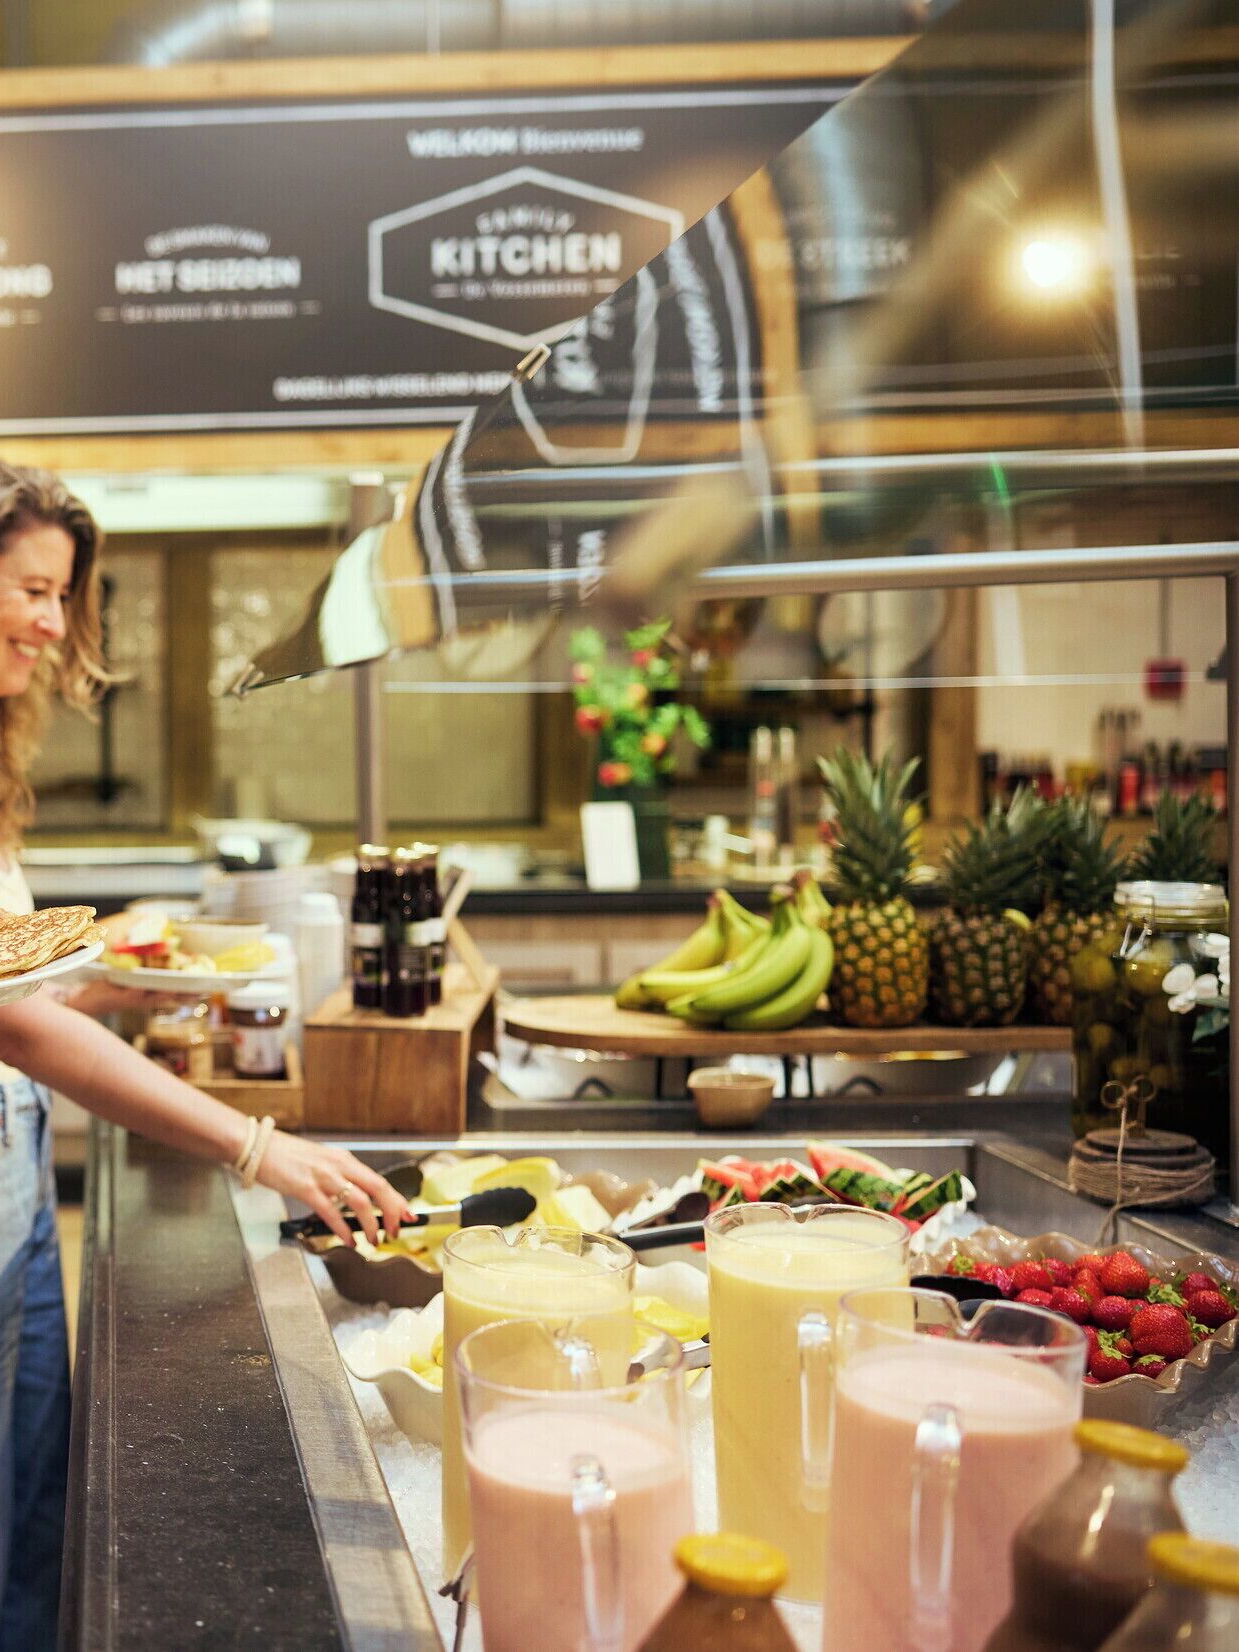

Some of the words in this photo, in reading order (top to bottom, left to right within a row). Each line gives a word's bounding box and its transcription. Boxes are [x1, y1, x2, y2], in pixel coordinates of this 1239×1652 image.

[407, 129, 517, 158] WELKOM
[521, 126, 645, 153] Bienvenue
[431, 232, 622, 277] KITCHEN
[115, 262, 175, 294] HET
[175, 256, 302, 292] SEIZOEN
